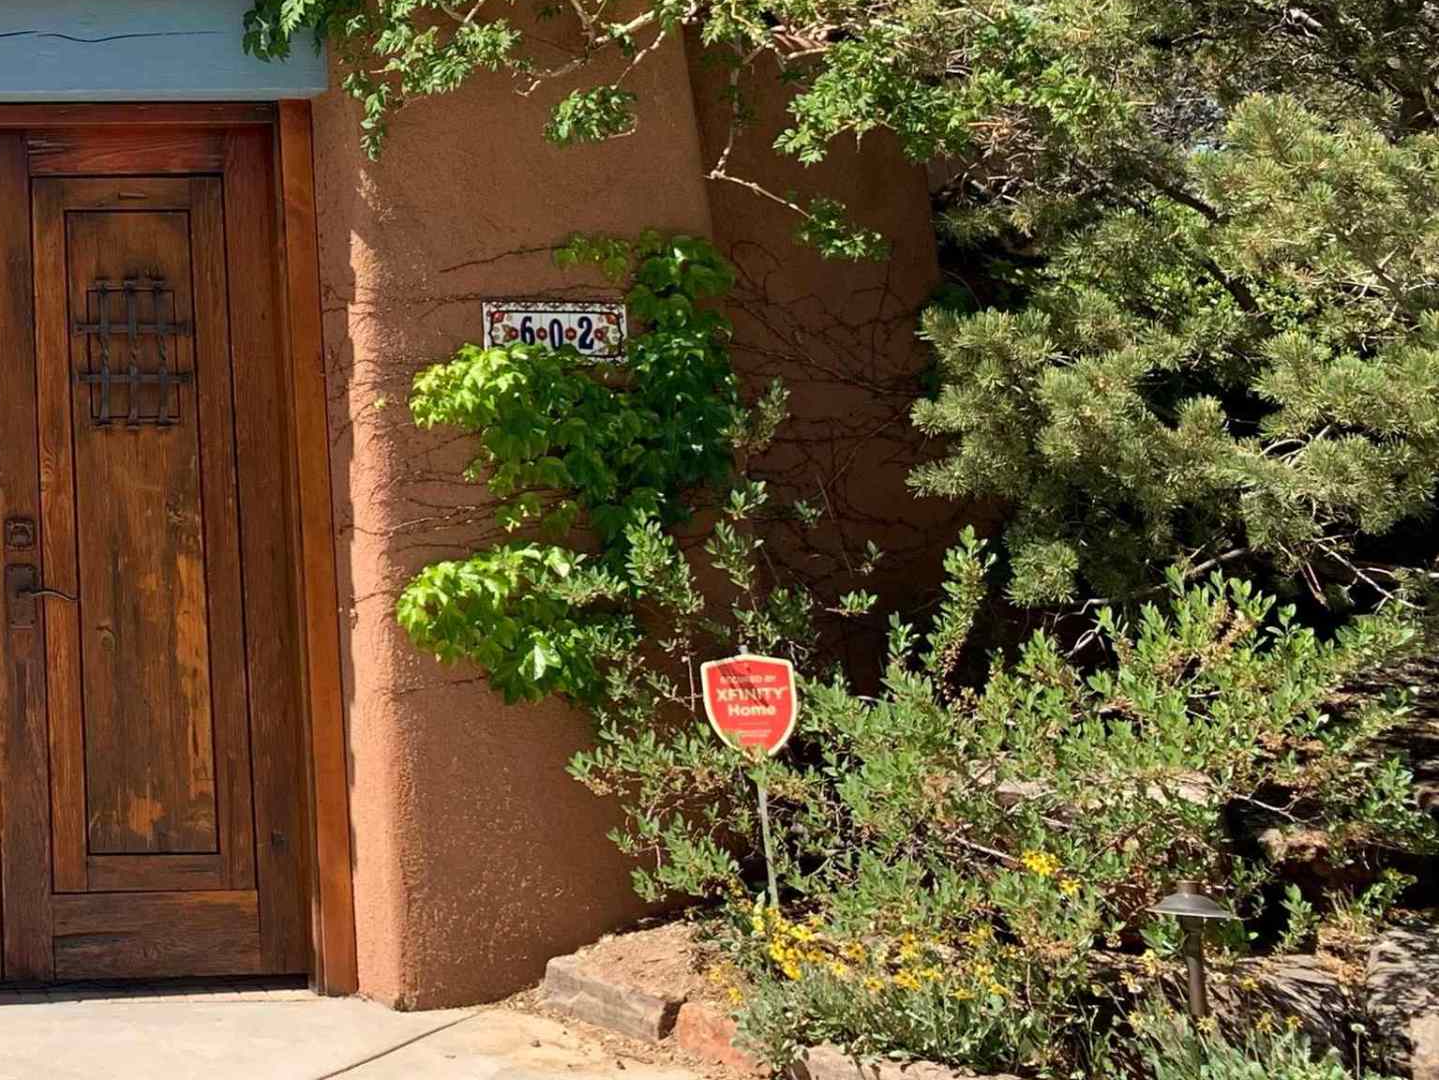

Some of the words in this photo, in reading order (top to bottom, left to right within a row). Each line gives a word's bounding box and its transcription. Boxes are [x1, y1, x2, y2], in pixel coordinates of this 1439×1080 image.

[520, 316, 594, 350] 602
[716, 687, 786, 702] XFINITY
[728, 704, 776, 716] Home
